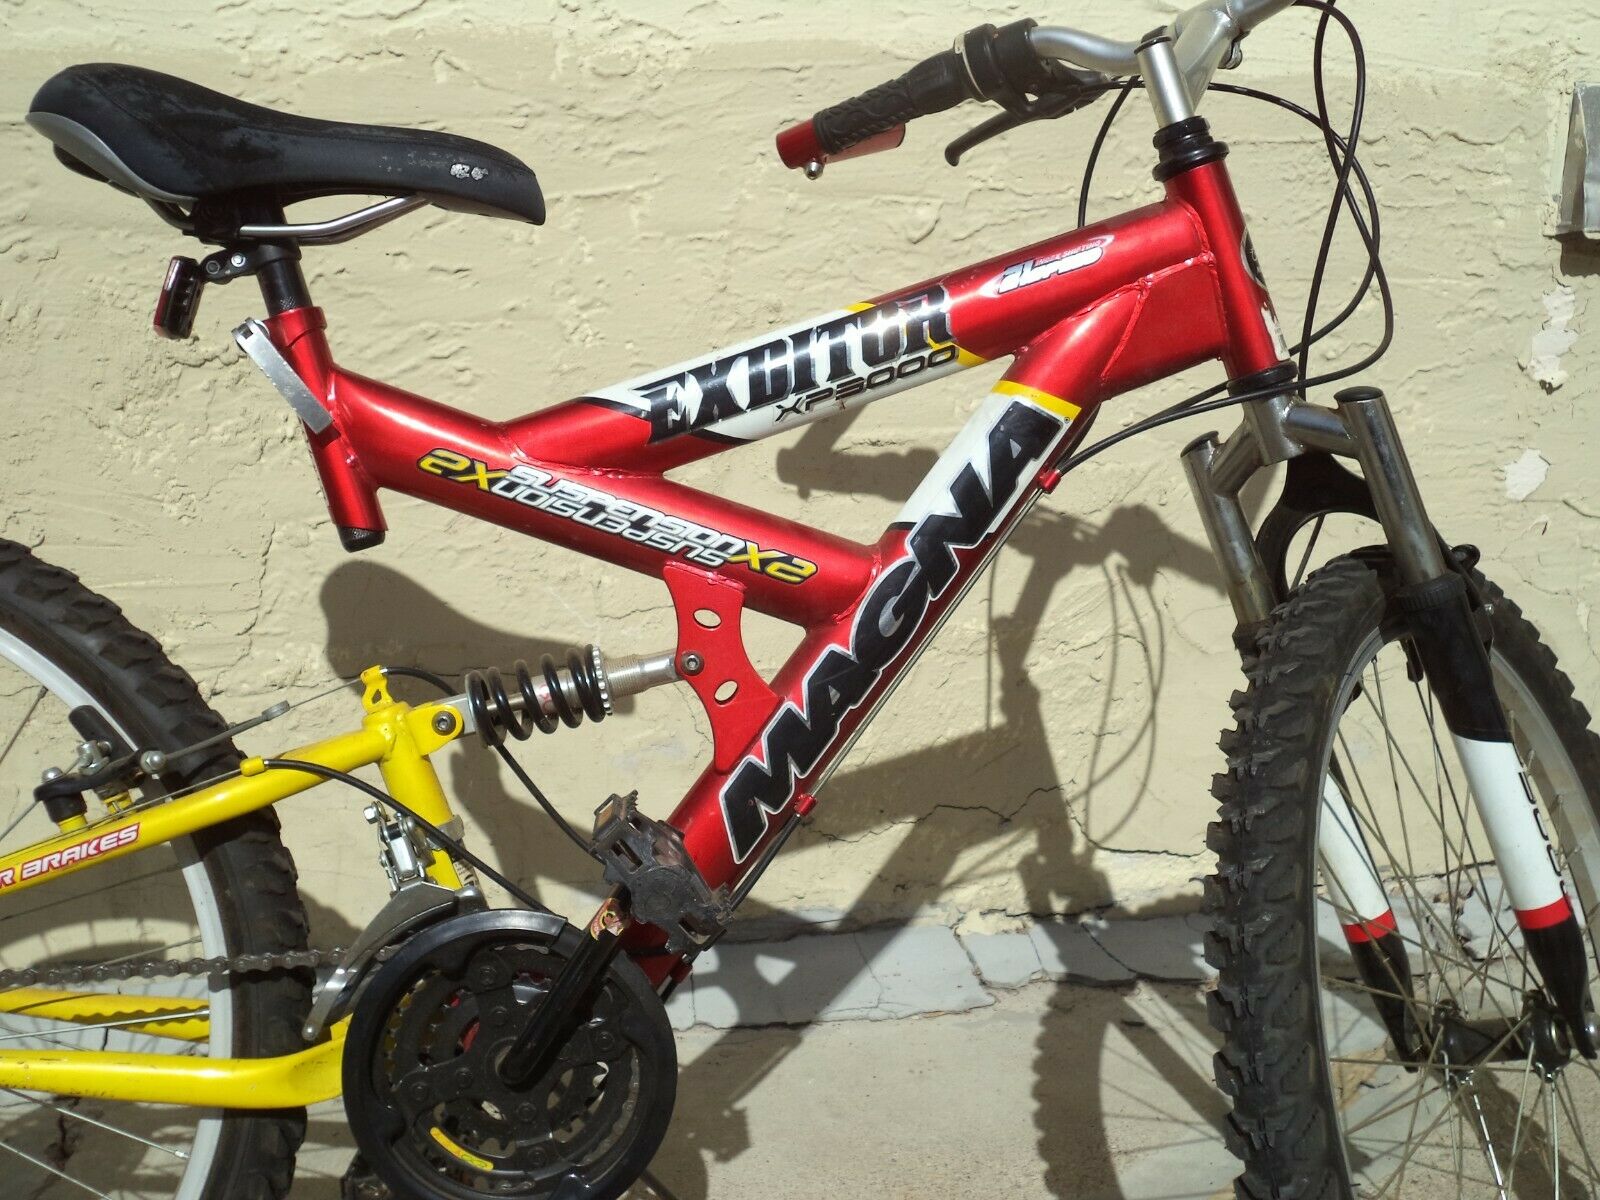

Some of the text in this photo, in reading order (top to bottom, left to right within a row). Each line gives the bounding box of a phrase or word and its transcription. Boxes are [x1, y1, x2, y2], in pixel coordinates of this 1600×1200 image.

[631, 283, 957, 445] EXCITOR
[775, 344, 960, 422] XP3000
[719, 400, 1064, 864] MAGNA
[20, 822, 140, 880] BRAKES
